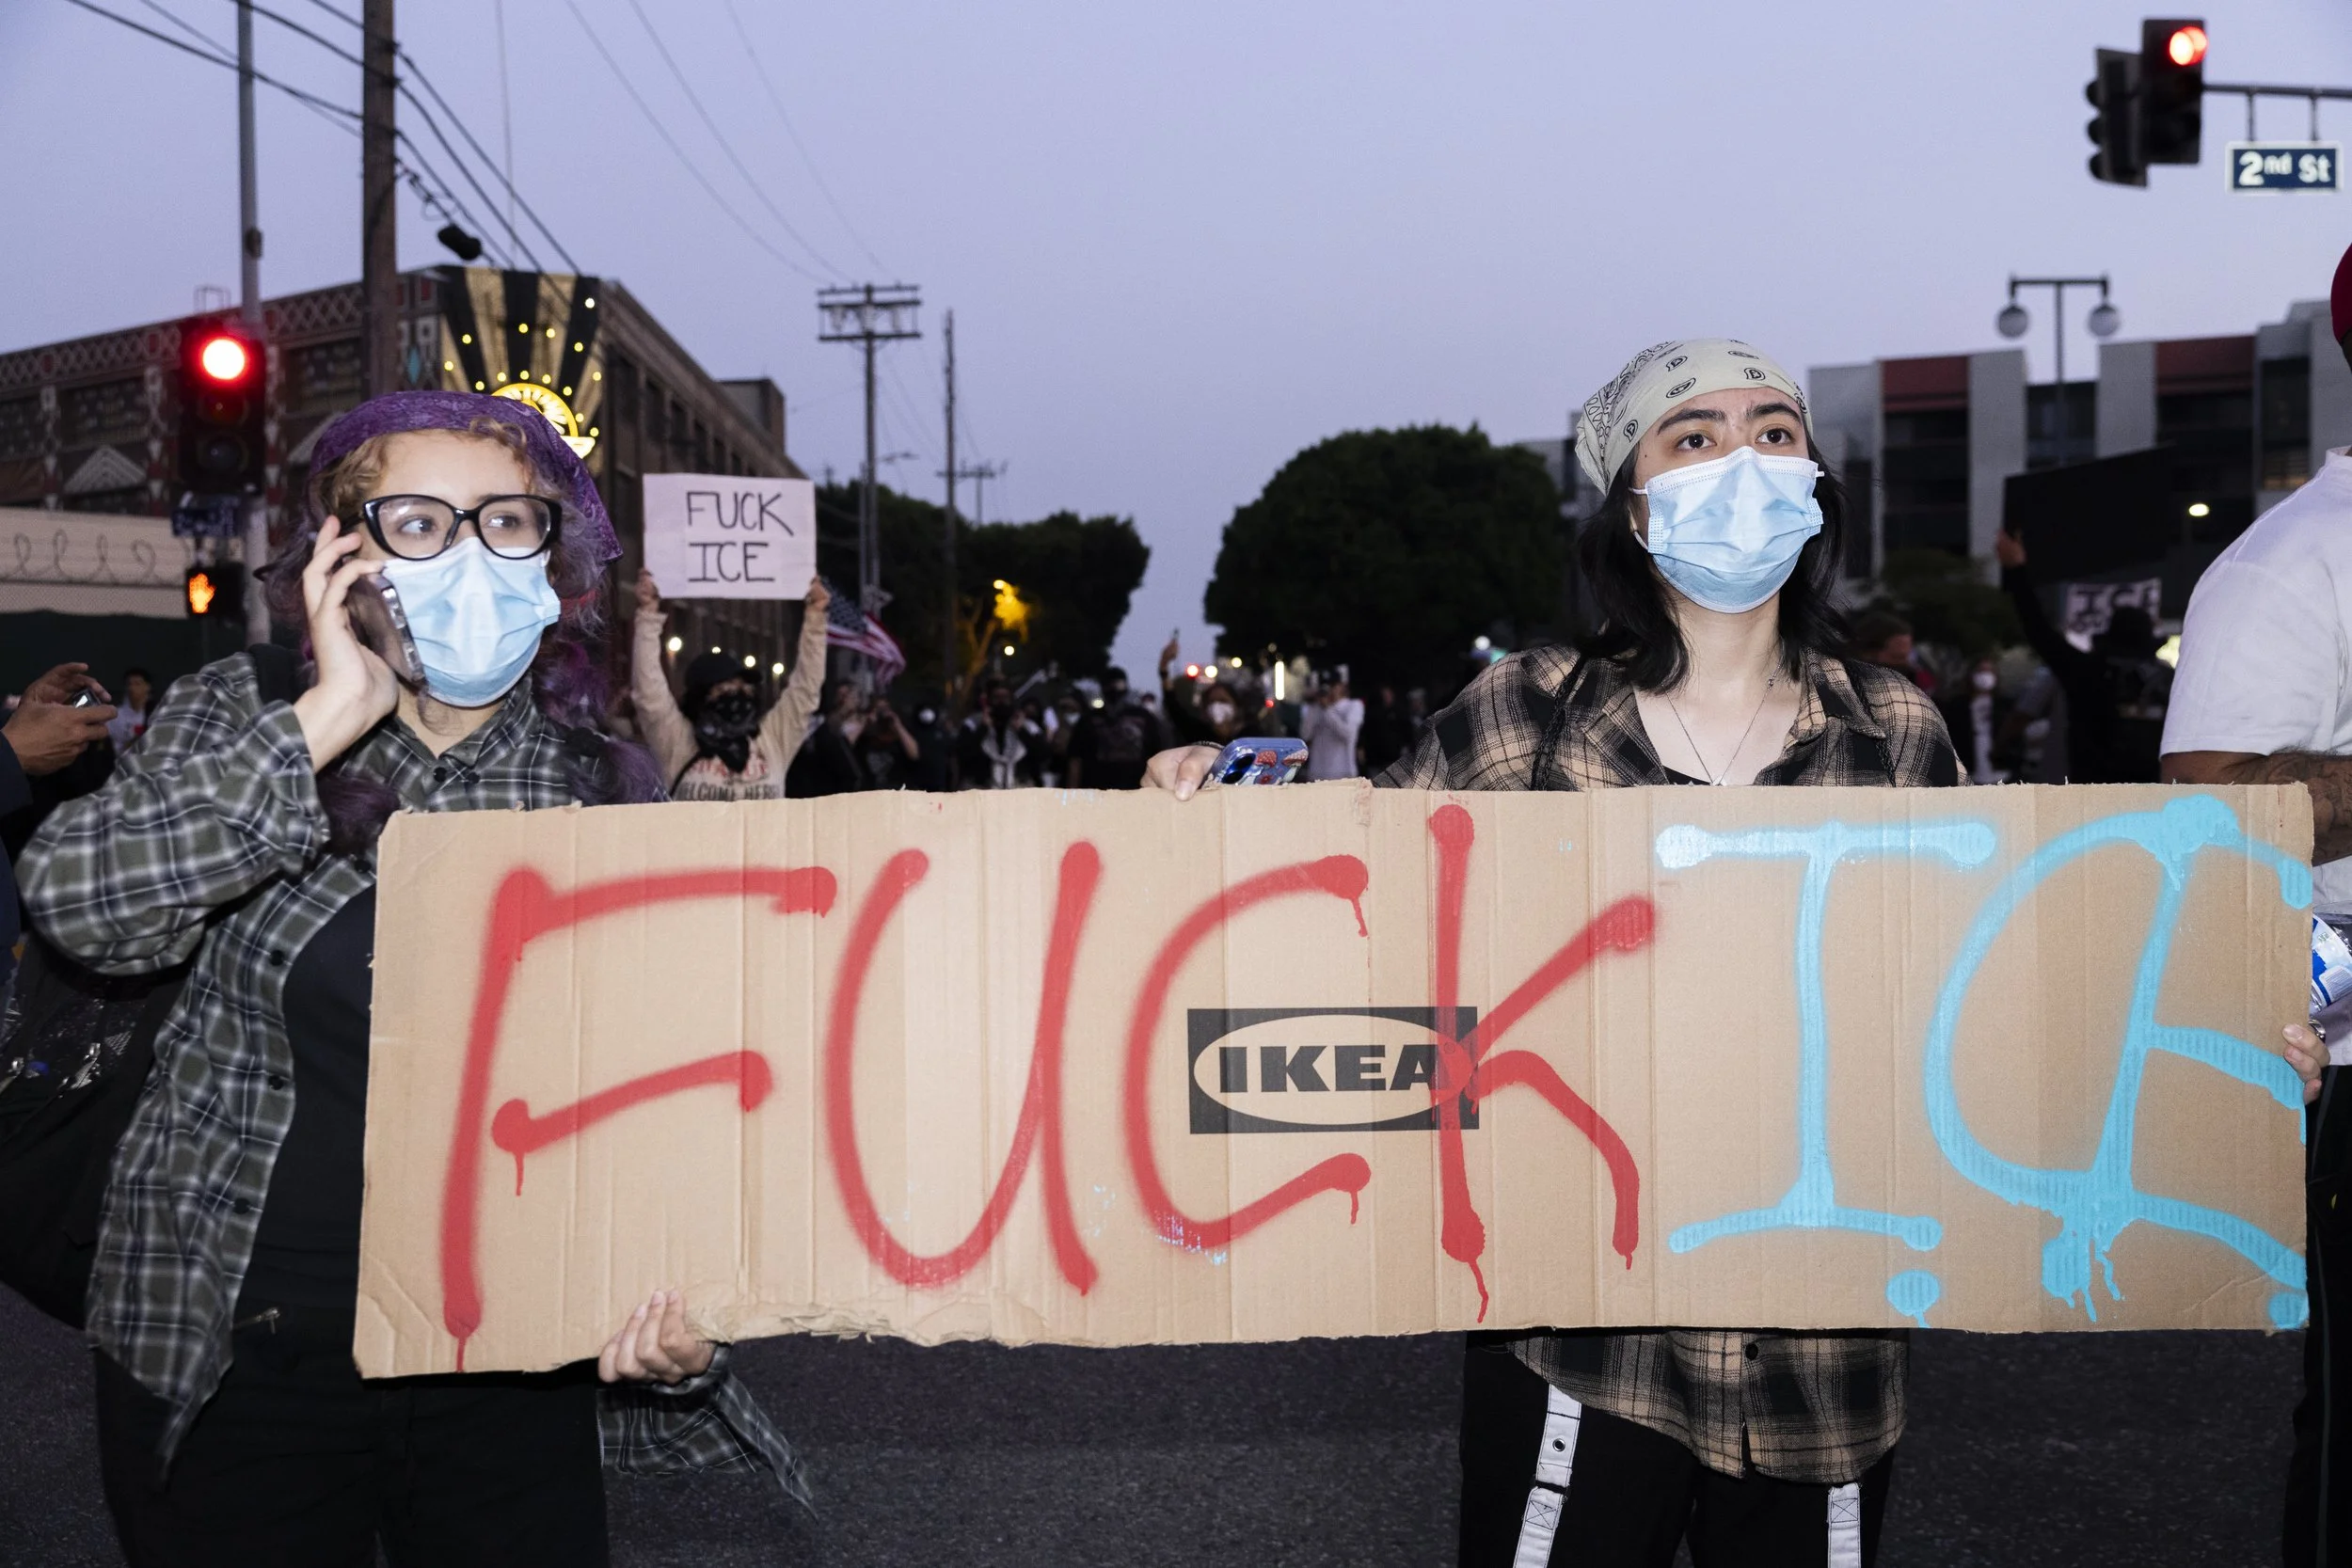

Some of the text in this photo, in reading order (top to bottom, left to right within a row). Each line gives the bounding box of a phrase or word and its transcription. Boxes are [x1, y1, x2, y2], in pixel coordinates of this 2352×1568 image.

[2239, 150, 2331, 186] 2nd St
[686, 490, 795, 537] FUCK
[688, 542, 776, 583] ICE
[441, 802, 1658, 1354] FUCK
[1219, 1043, 1452, 1093] IKEA
